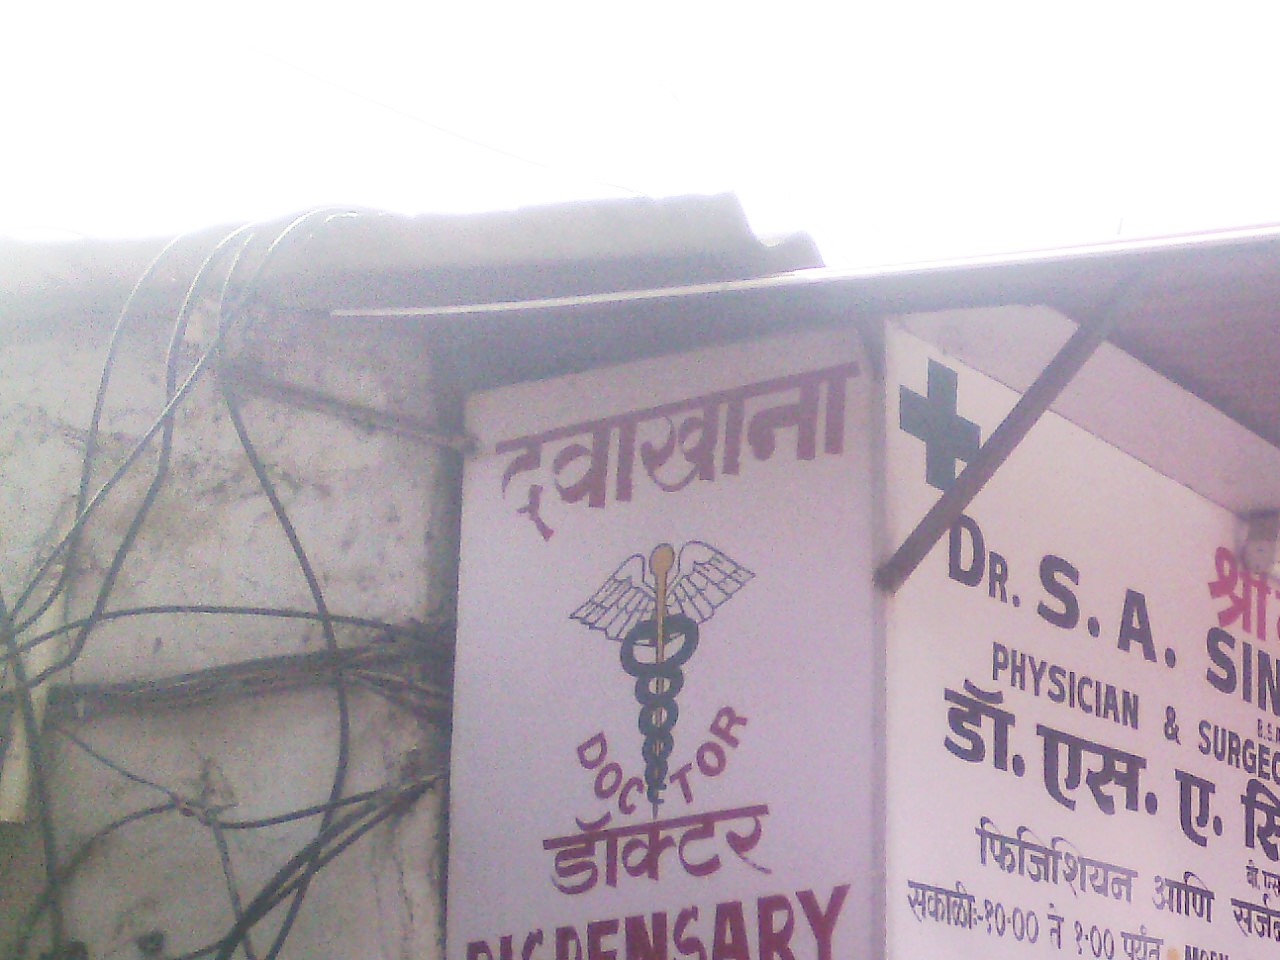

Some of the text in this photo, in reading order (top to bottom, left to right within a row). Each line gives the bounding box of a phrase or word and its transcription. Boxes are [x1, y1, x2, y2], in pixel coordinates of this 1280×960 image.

[495, 361, 861, 541] दवाखाना
[948, 514, 1021, 607] DR.
[992, 641, 1139, 730] PHYSICIAN
[1163, 705, 1182, 745] &
[577, 706, 748, 815] DOCTOR
[944, 679, 1025, 778] डॉ.
[1036, 723, 1158, 815] एस.
[1175, 769, 1223, 847] ए.
[543, 804, 772, 895] डॉक्टर
[975, 816, 1138, 903] फिजिशियन
[1152, 872, 1215, 923] आणि
